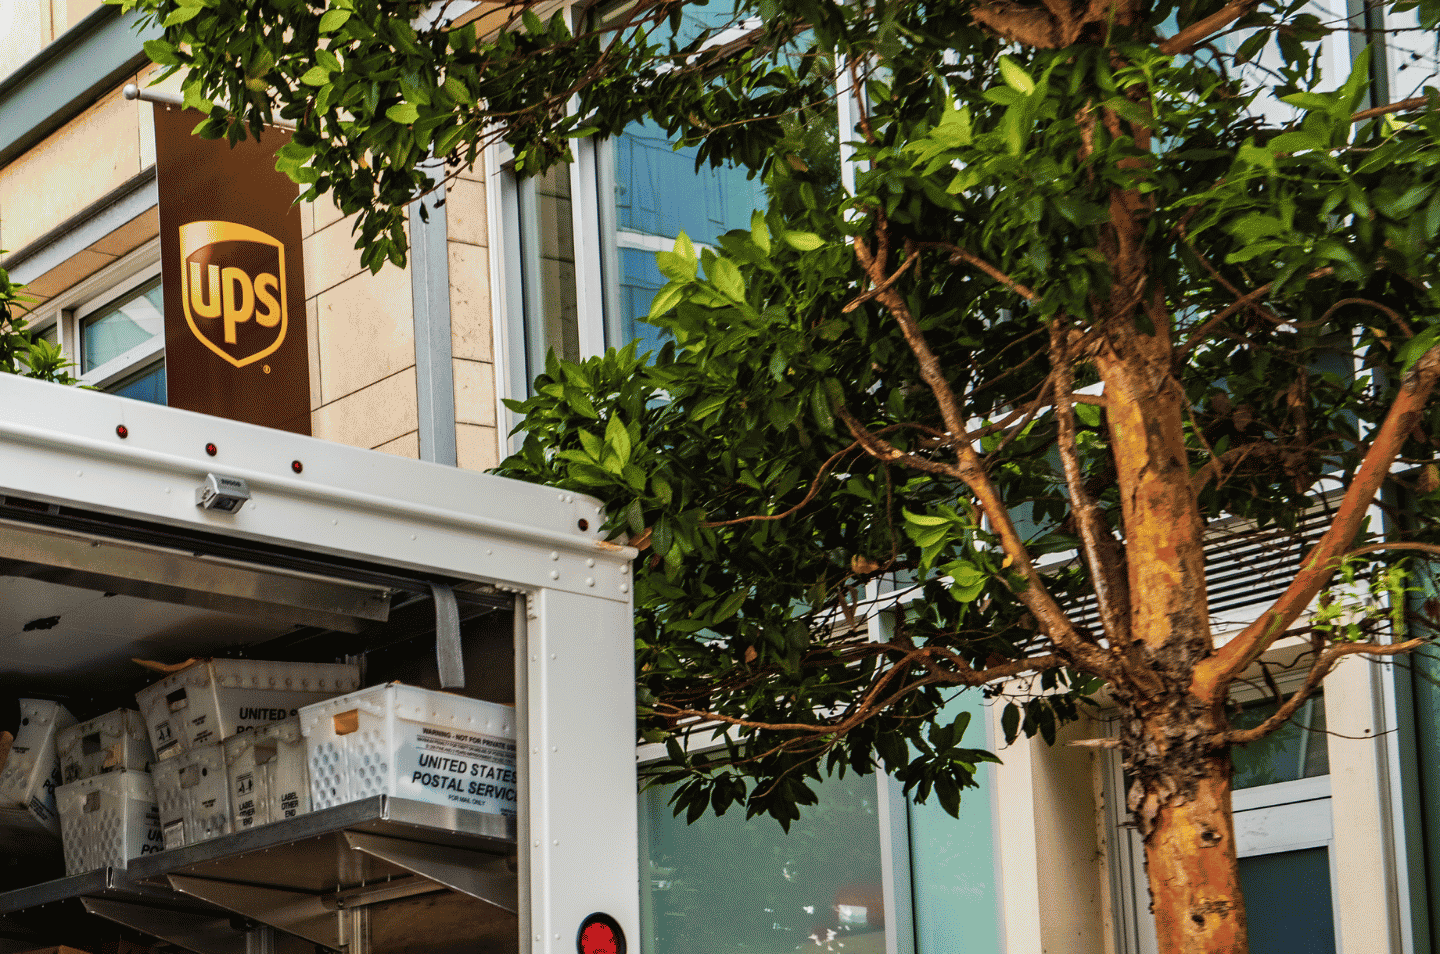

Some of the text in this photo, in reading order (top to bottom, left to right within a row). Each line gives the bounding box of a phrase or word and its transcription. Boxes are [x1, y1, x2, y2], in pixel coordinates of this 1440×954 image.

[189, 261, 282, 345] ups
[239, 707, 287, 721] UNITED
[411, 770, 465, 793] POSTAL
[418, 753, 517, 785] UNITED STATES
